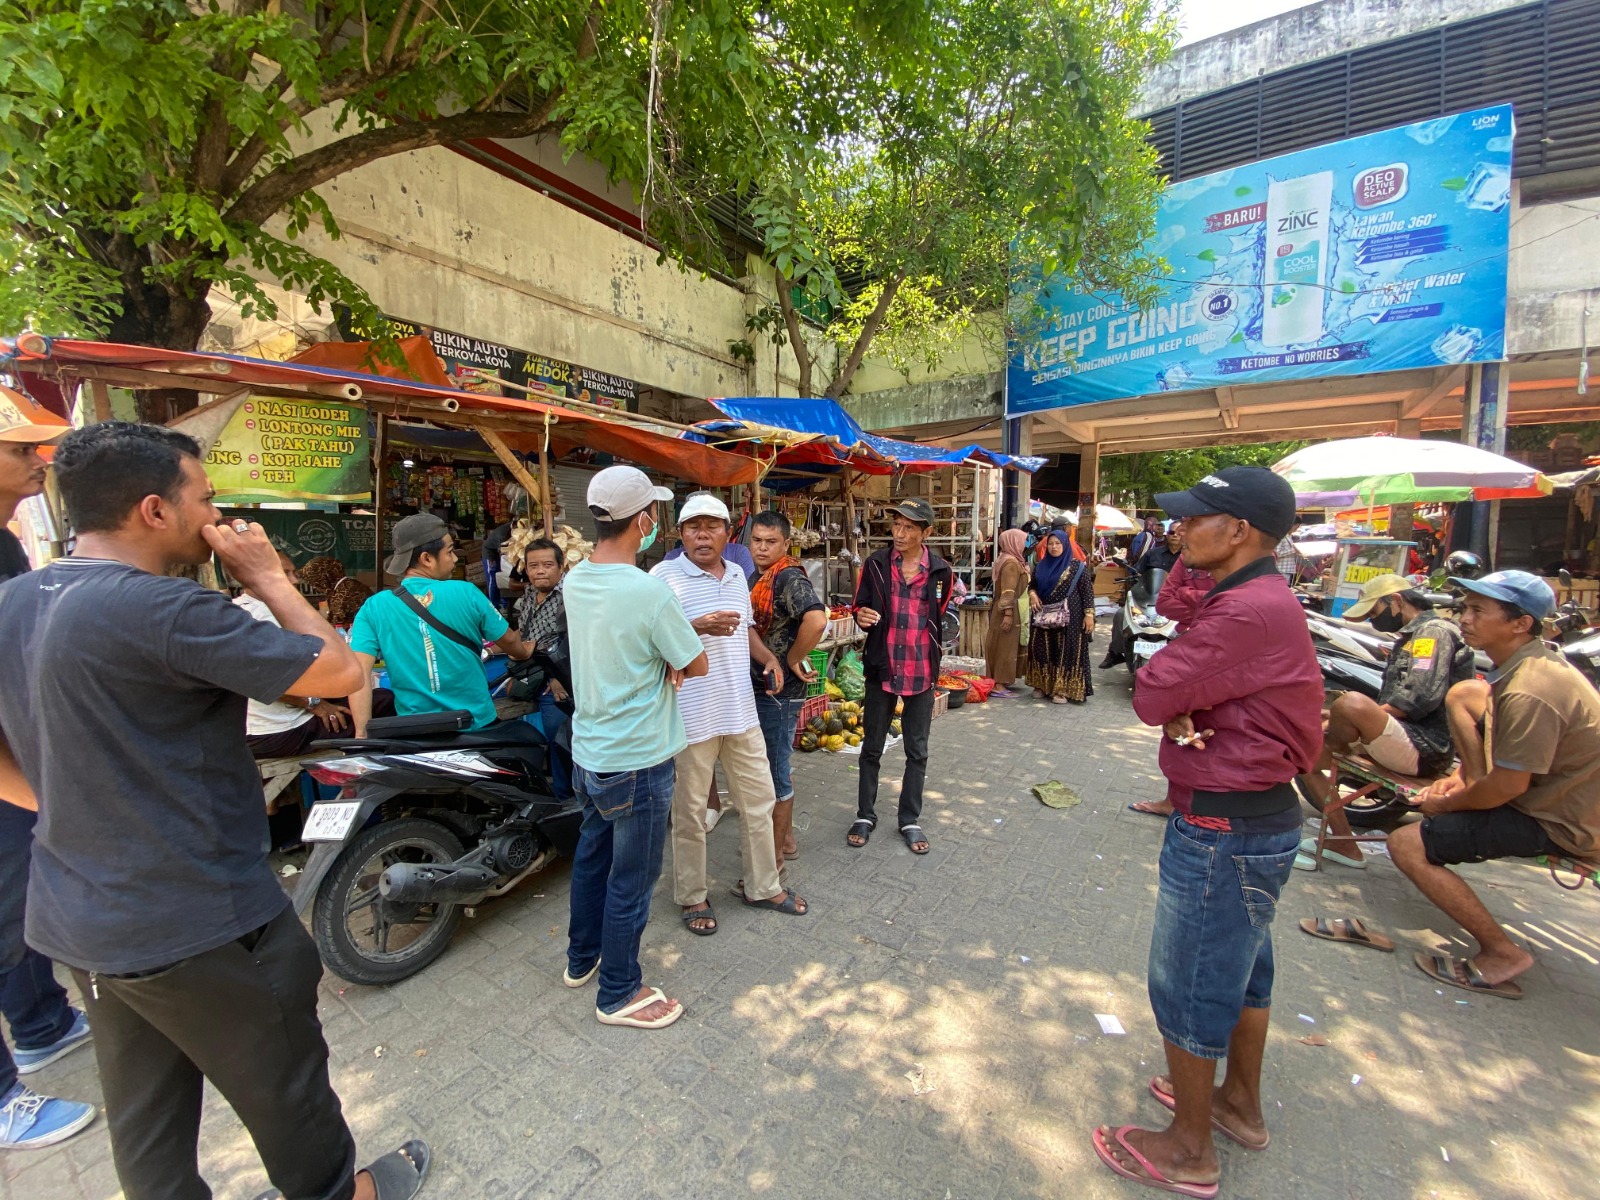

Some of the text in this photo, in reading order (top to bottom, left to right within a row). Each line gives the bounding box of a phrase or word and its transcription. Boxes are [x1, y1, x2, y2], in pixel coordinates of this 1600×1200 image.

[1472, 114, 1500, 126] LION
[1363, 180, 1395, 193] ACTIVE
[1364, 171, 1395, 187] DEO
[1363, 186, 1395, 199] SCALP
[1224, 206, 1261, 226] BARU!
[1354, 210, 1395, 228] Lawan
[1350, 219, 1406, 239] Ketombe
[1283, 254, 1317, 269] COOL
[1283, 263, 1316, 275] BOOSTER
[1424, 271, 1466, 289] Water
[1055, 310, 1084, 332] STAY
[433, 330, 471, 350] BIKIN
[473, 340, 508, 359] AUTO
[1023, 301, 1198, 372] KEEP GOING
[434, 344, 512, 369] TERKOYA-KOYA
[526, 354, 570, 371] KUAH KOYA
[1031, 329, 1217, 386] SENSASI DINGINNYA BIKIN KEEP GOING
[1241, 347, 1340, 370] KETOMBE NO WORRIES
[522, 360, 570, 383] MEDOK
[582, 368, 634, 390] BIKIN AUTO
[582, 379, 635, 399] TERKOYA-KOYA
[258, 401, 350, 422] NASI LODEH
[259, 418, 362, 438] LONTONG MIE
[308, 439, 355, 454] TAHU)
[261, 453, 342, 468] KOPI JAHE
[263, 470, 295, 483] TEH
